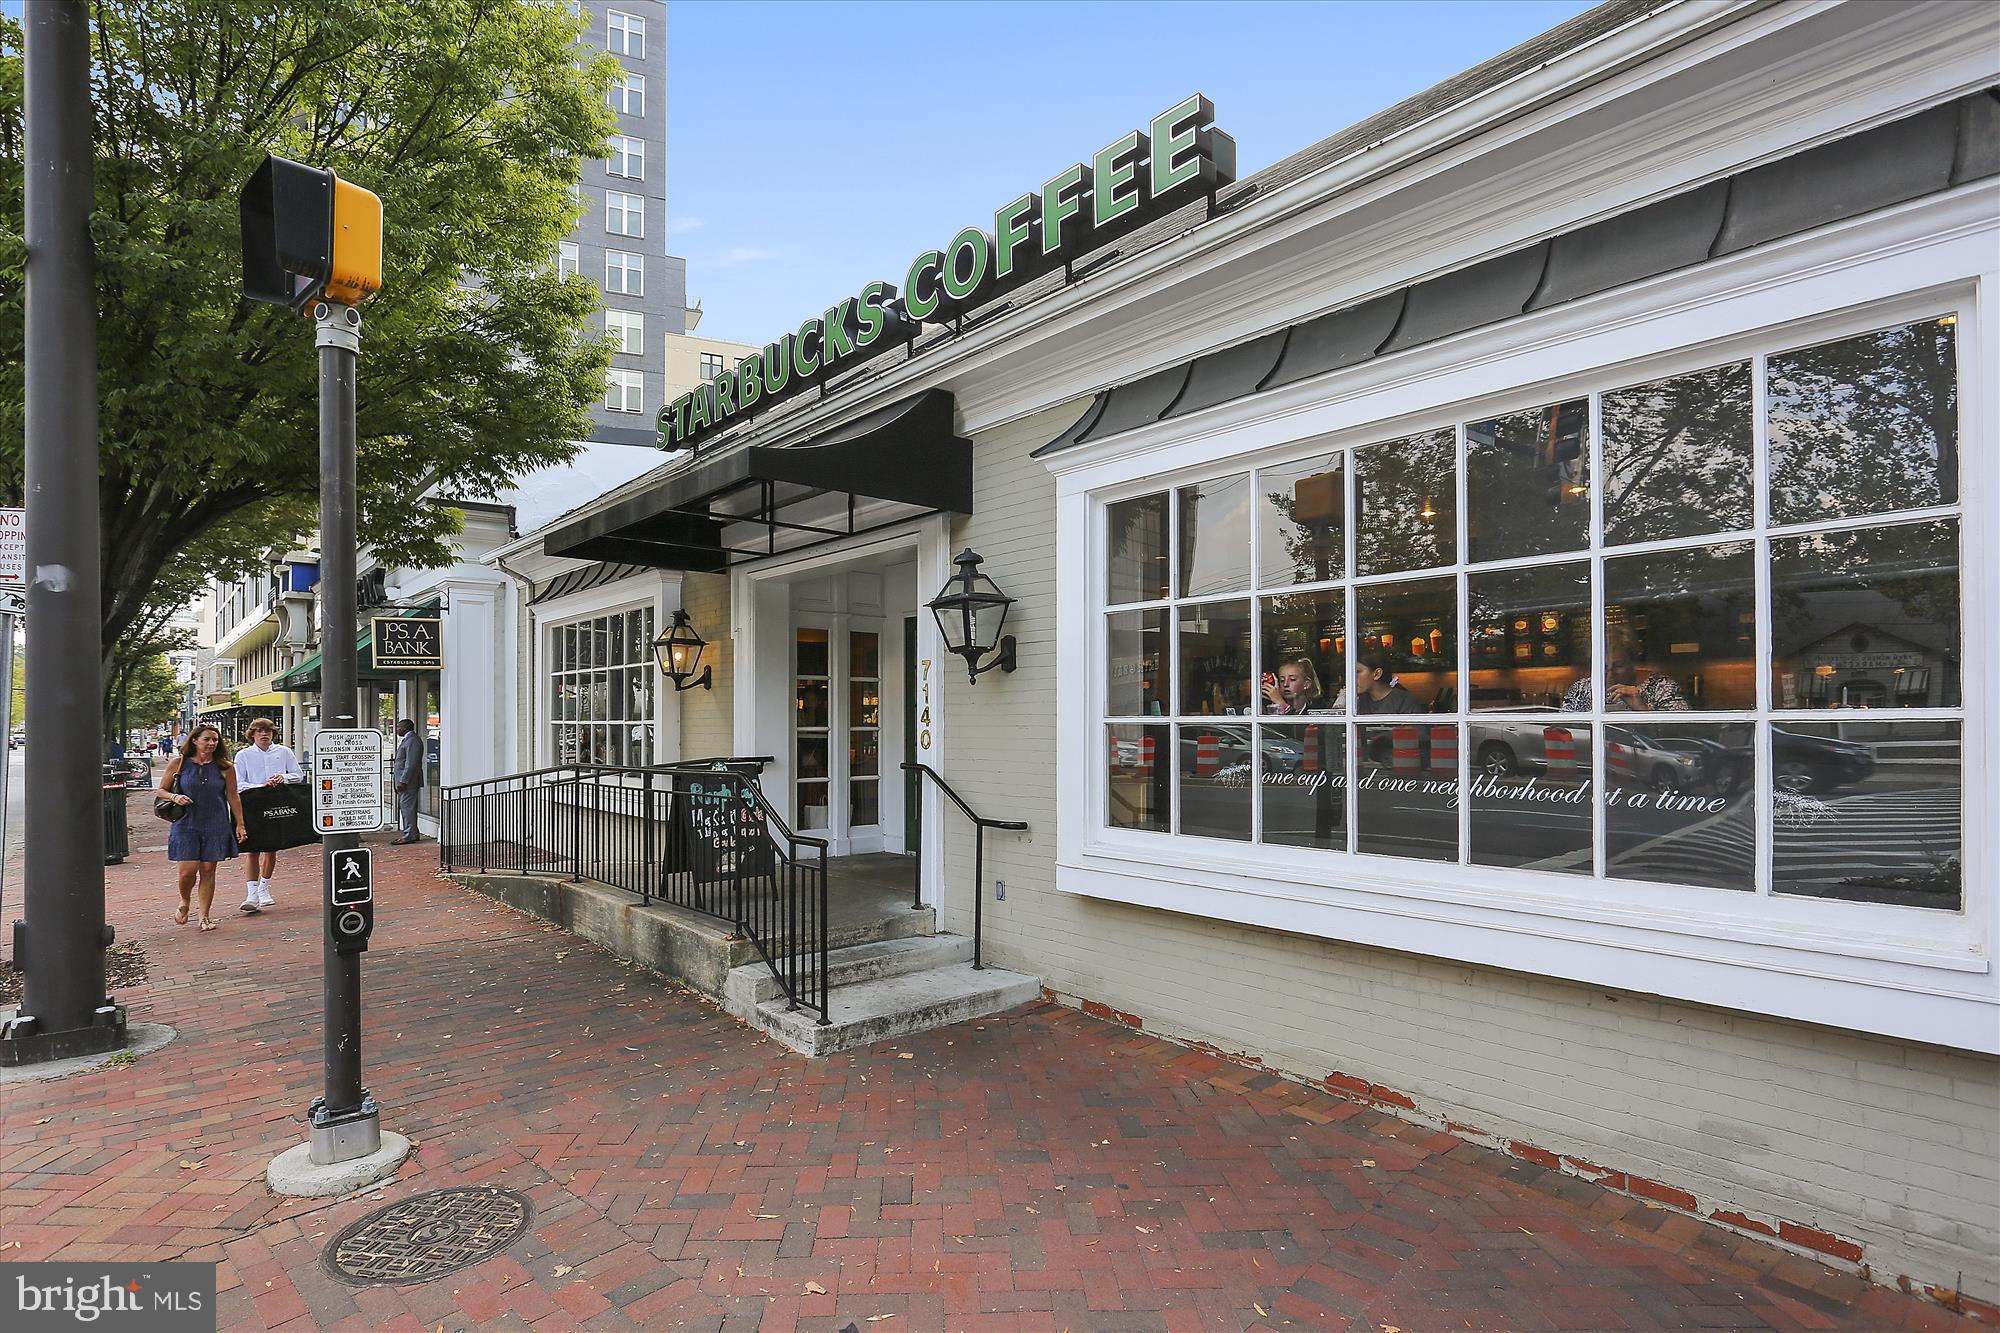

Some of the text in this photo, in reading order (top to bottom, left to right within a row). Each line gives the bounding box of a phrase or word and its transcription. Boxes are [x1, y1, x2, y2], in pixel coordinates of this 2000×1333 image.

[655, 92, 1205, 451] STARBUCKS COFFEE
[0, 514, 20, 527] NO
[412, 623, 434, 640] A.
[385, 640, 432, 655] BANK
[920, 659, 932, 750] 7140
[1261, 771, 1294, 785] one
[1297, 770, 1328, 796] cup
[1331, 768, 1379, 790] ad
[1378, 776, 1418, 793] one
[1422, 774, 1591, 808] neighborhood
[1628, 791, 1650, 809] a
[1655, 789, 1727, 813] time
